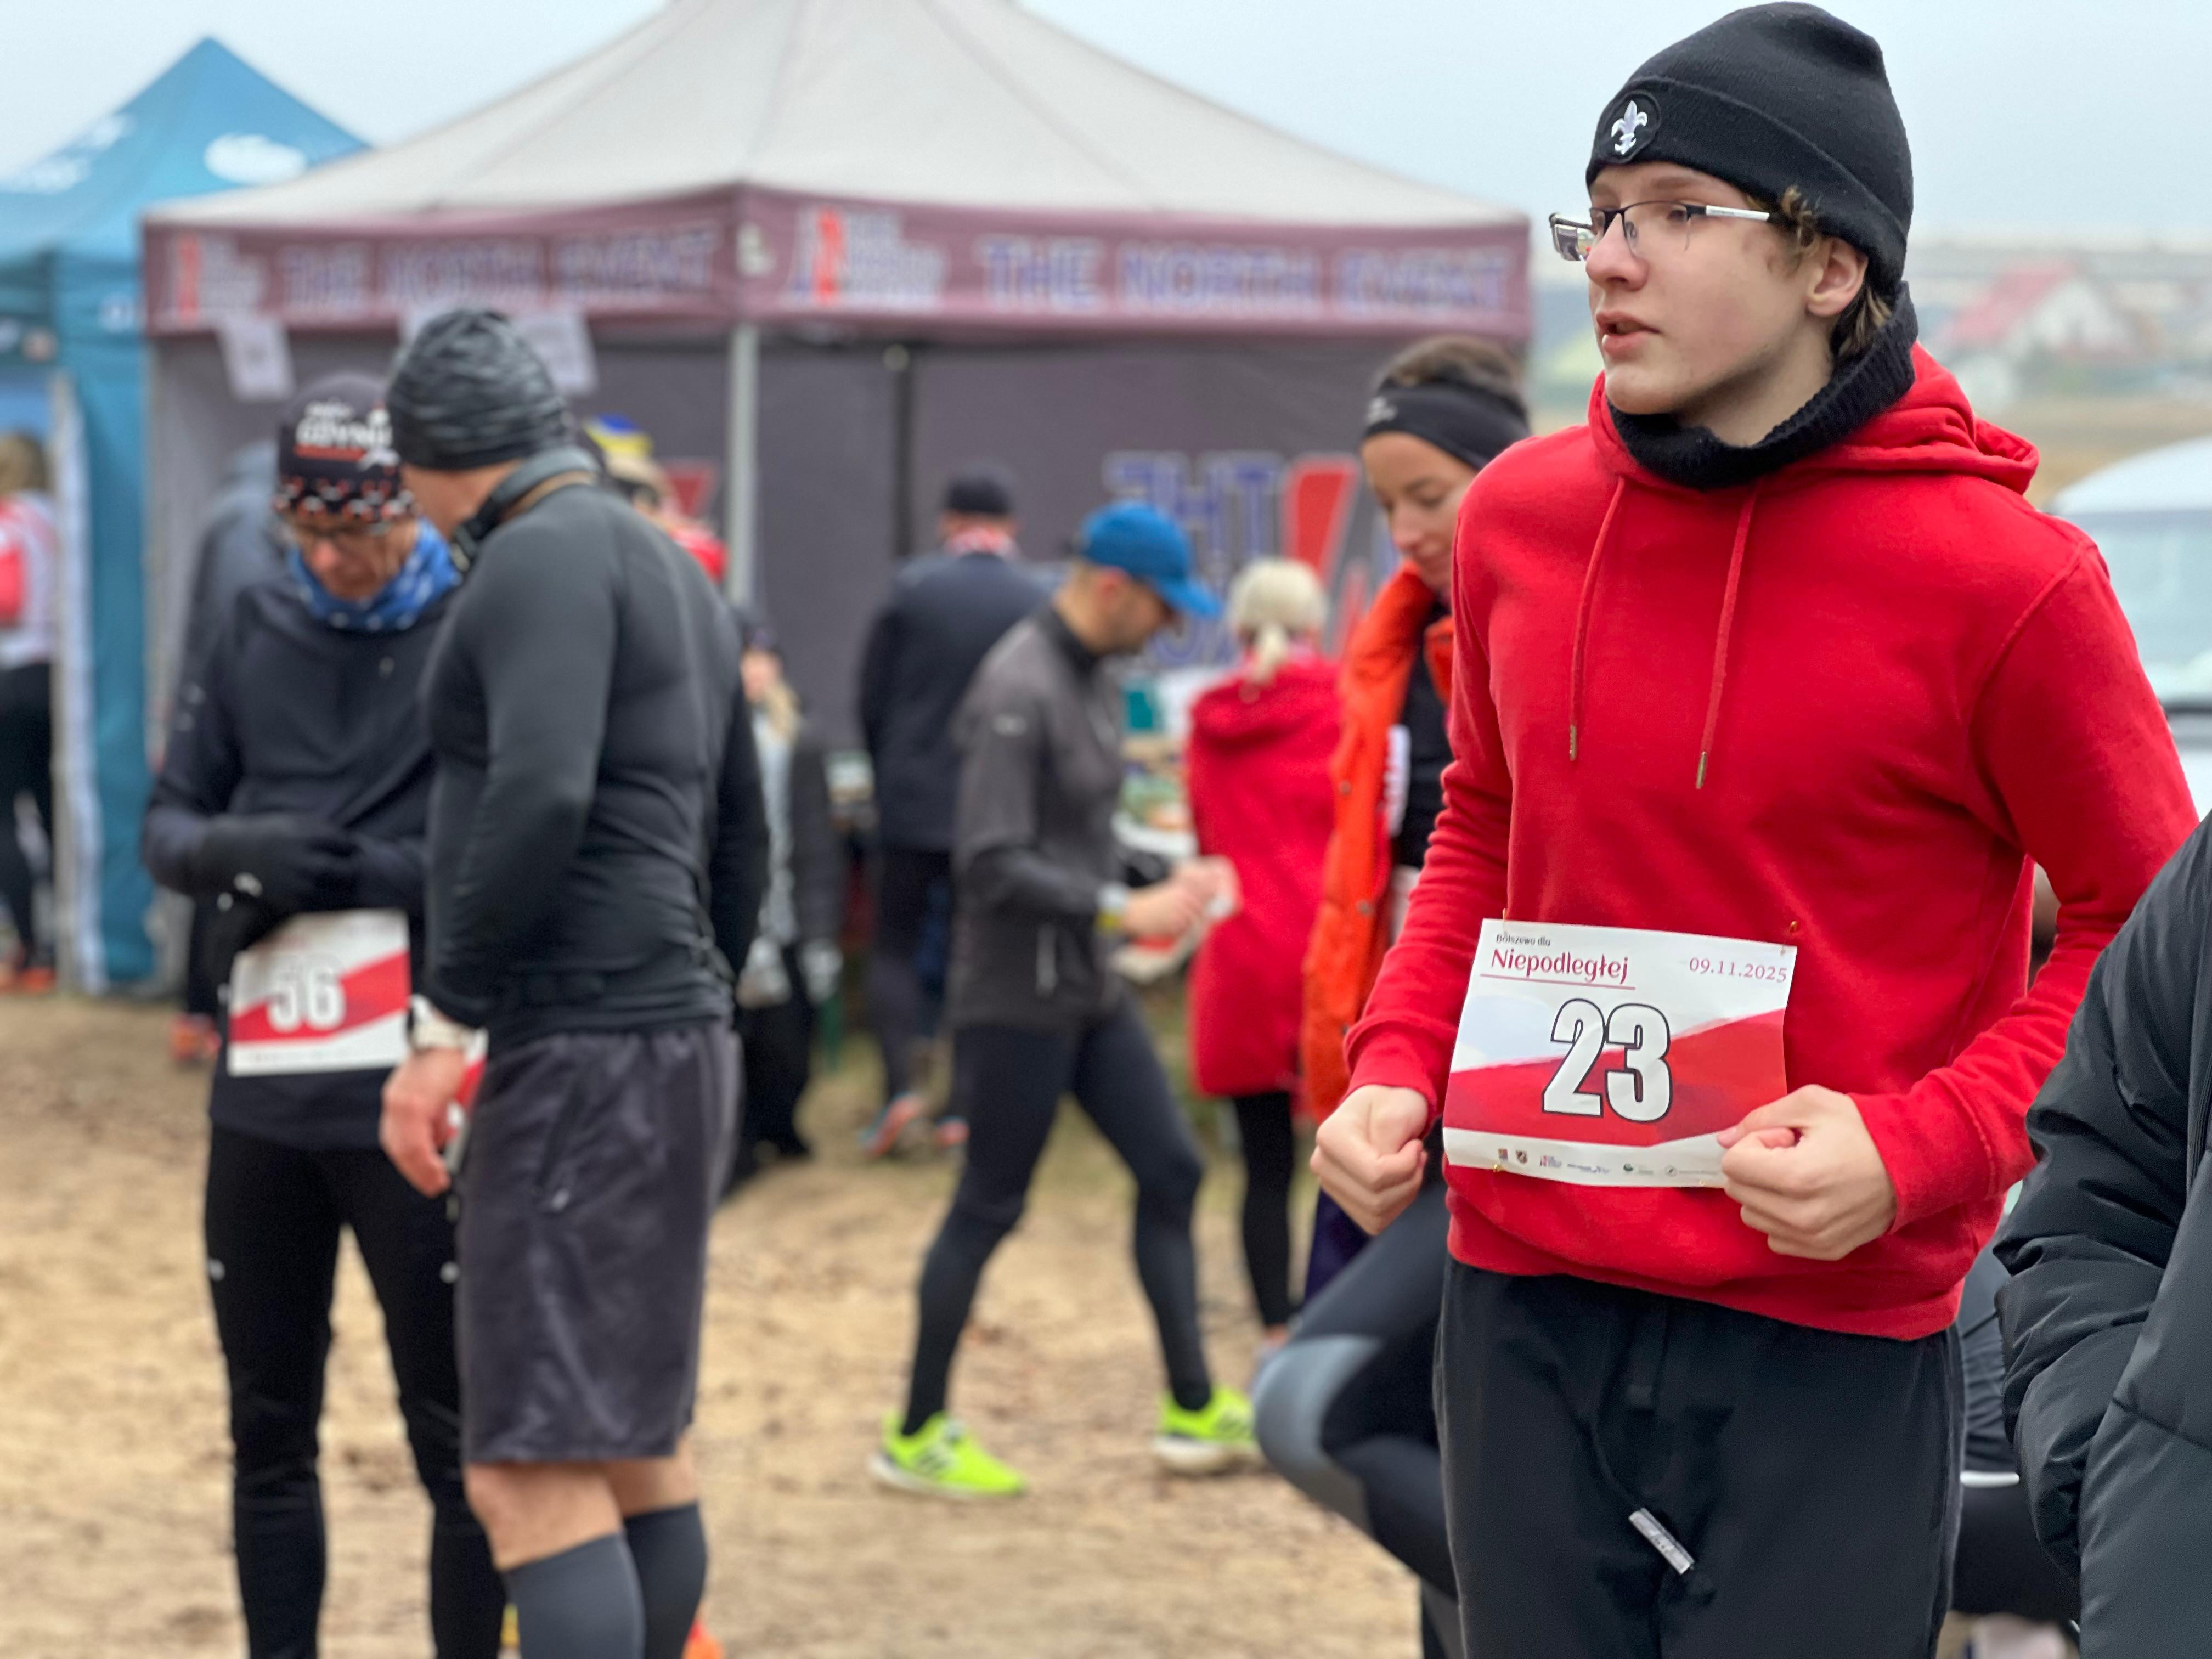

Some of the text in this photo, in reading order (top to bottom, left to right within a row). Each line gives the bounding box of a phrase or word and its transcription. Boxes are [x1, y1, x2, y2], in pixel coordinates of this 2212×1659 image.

[975, 233, 1103, 314] THE
[267, 955, 347, 1034] 56
[1491, 947, 1629, 985] Niepodległej
[1689, 956, 1788, 984] 09.11.2025
[1541, 997, 1673, 1123] 23
